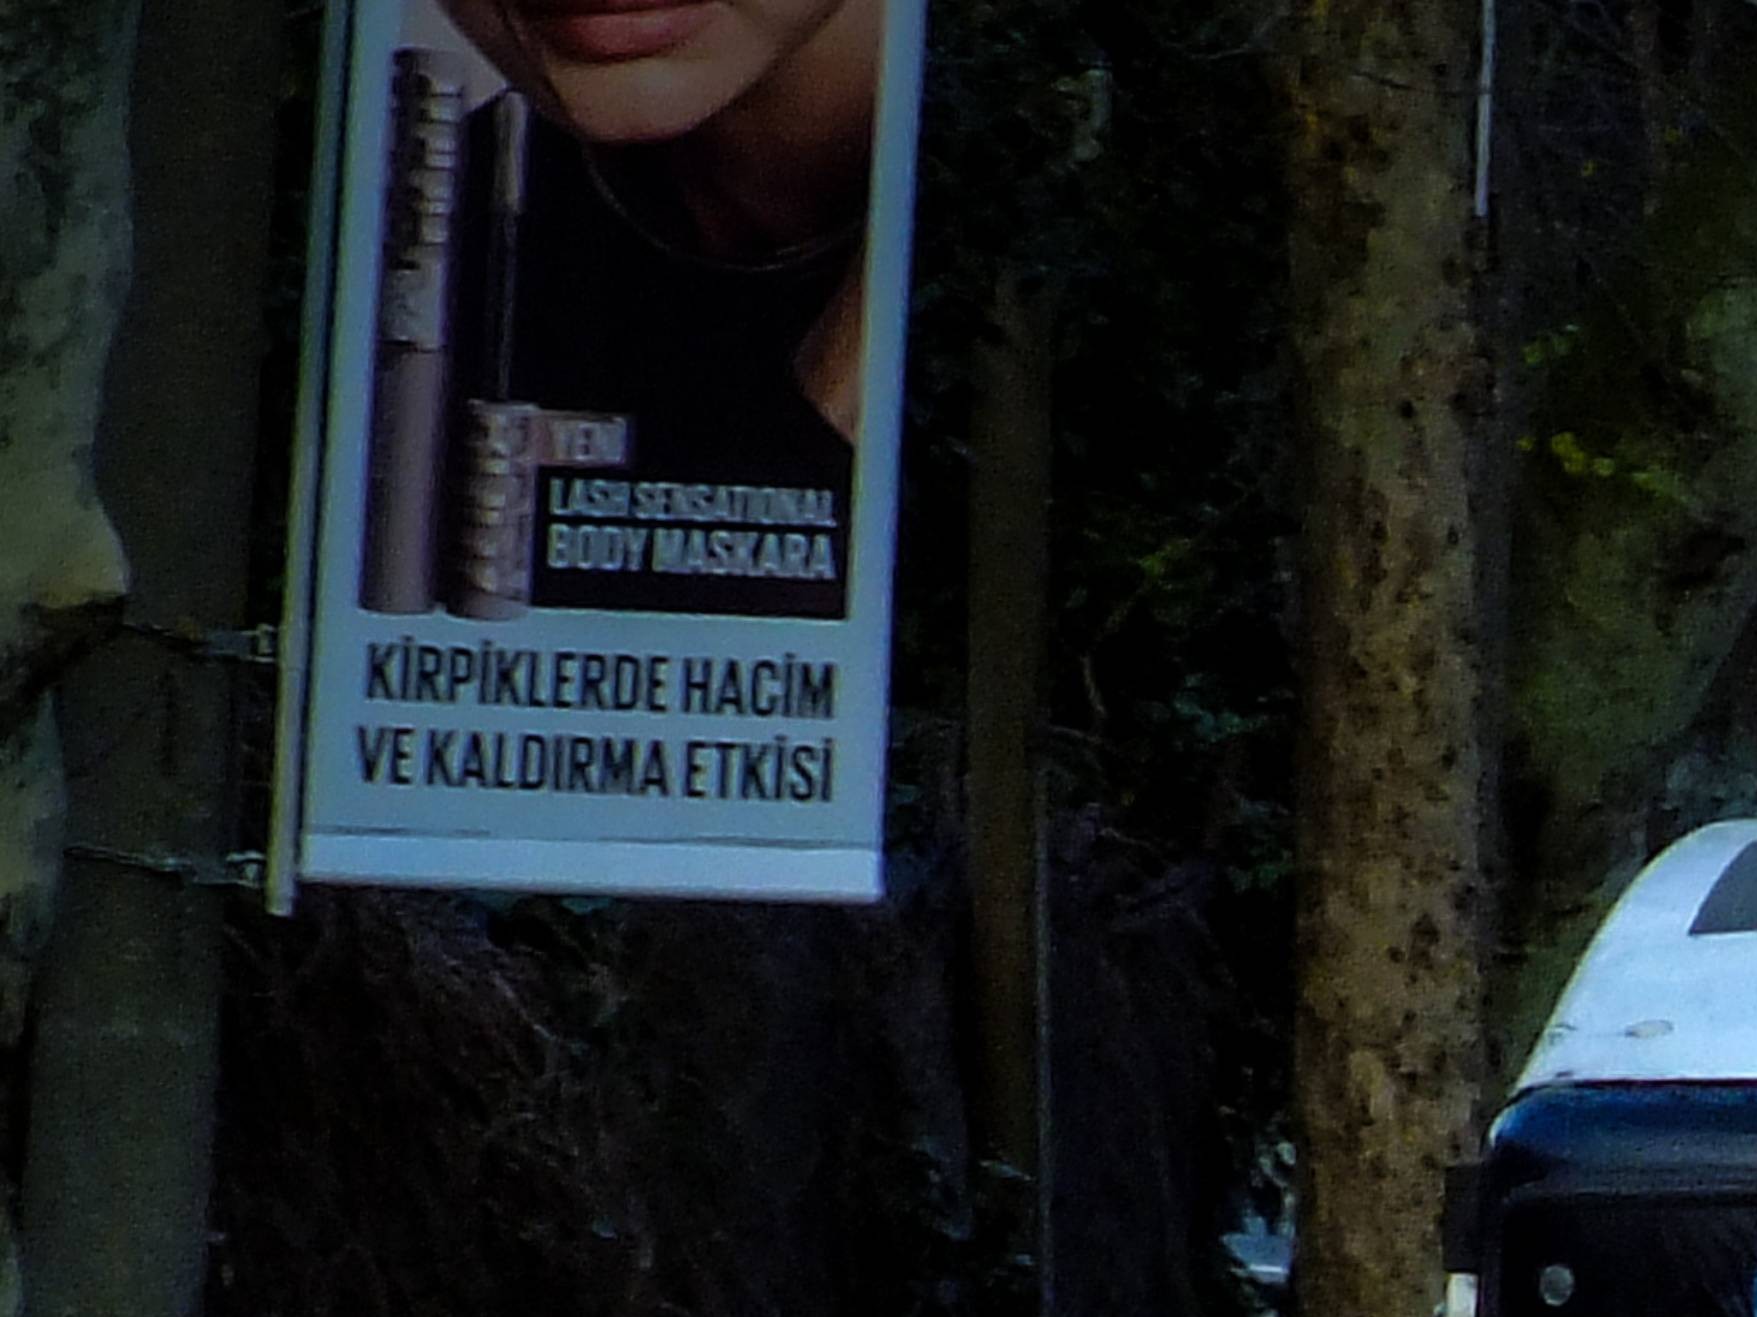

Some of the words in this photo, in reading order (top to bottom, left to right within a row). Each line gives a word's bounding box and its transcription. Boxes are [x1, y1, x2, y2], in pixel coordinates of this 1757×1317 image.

[548, 523, 648, 571] BODY
[652, 527, 838, 580] MASKARA
[366, 634, 669, 714] KİRPİKLERDE
[681, 652, 837, 720] HACİM
[357, 724, 416, 786] VE
[426, 727, 670, 797] KALDIRMA
[685, 734, 837, 803] ETKİSİ
